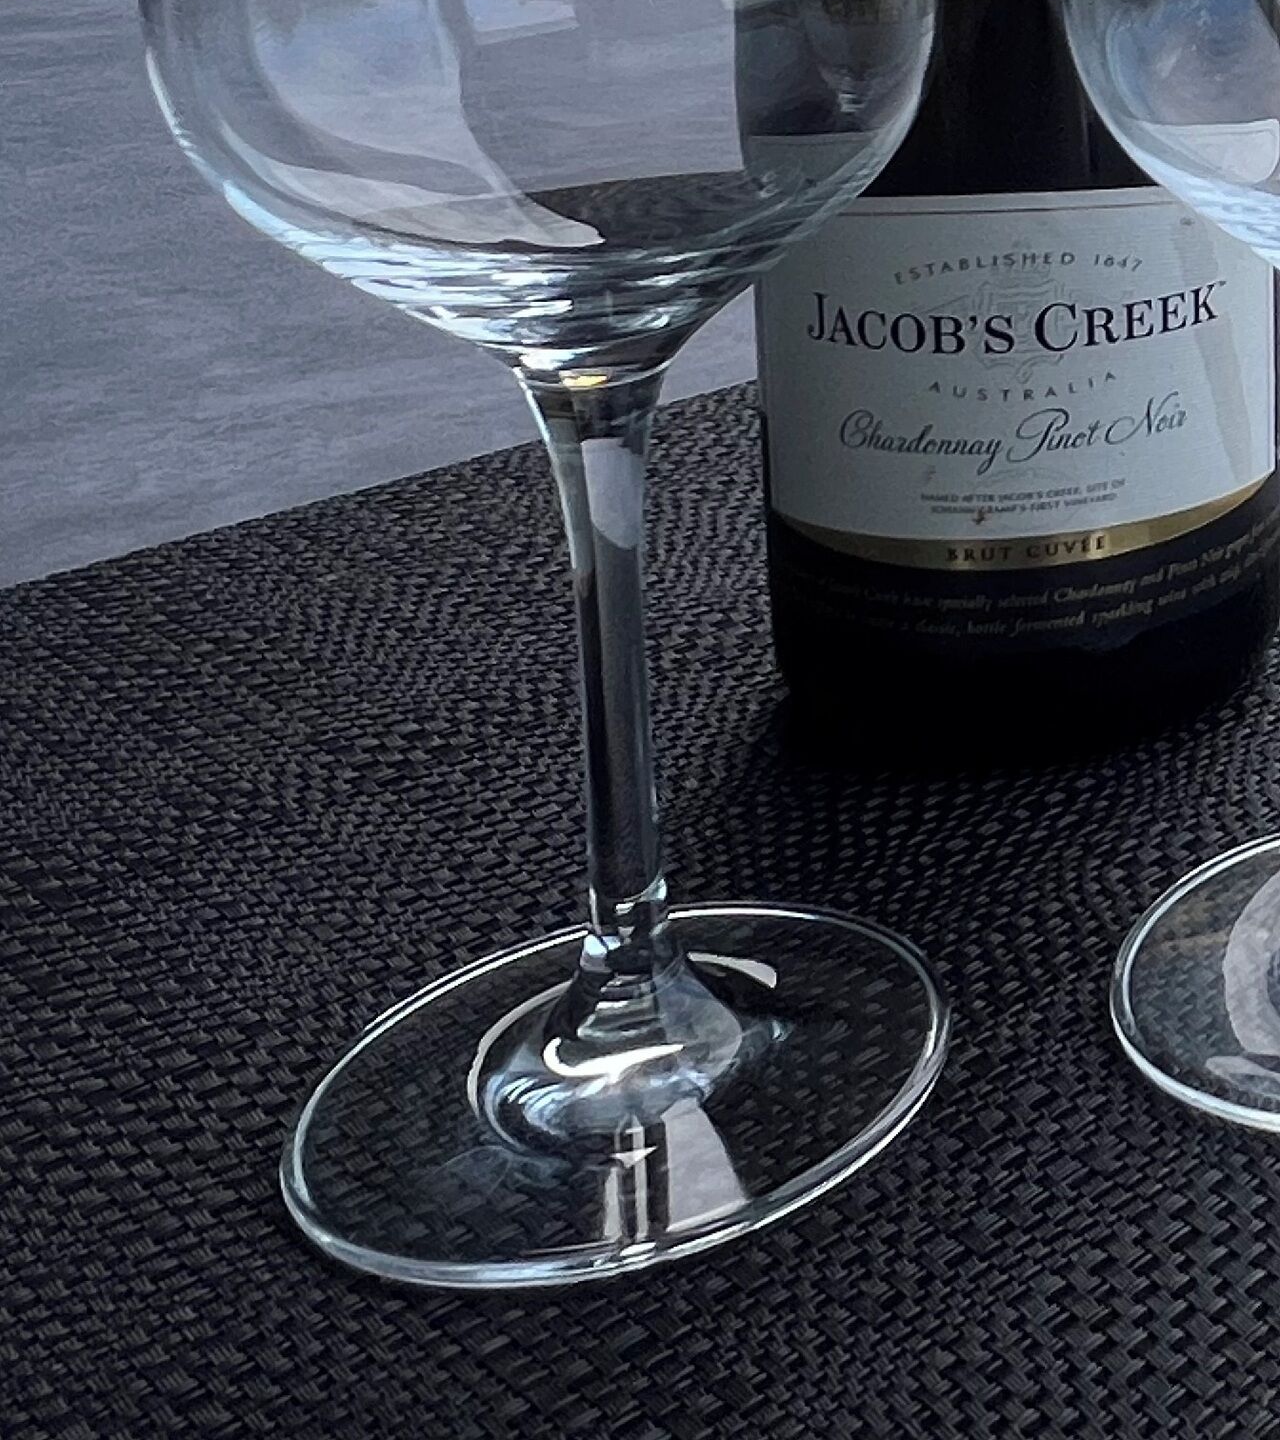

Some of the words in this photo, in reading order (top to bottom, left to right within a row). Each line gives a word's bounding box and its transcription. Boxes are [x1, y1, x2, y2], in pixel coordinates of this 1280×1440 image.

[893, 251, 1076, 286] ESTABLISHED
[806, 291, 1016, 355] JACOB'S
[1034, 281, 1219, 352] CREEK
[927, 371, 1117, 403] AUSTRALIA
[839, 408, 1003, 477] Chardonnay
[1006, 407, 1102, 464] Pinot
[1103, 390, 1189, 446] Noir
[945, 546, 1012, 562] BRUT
